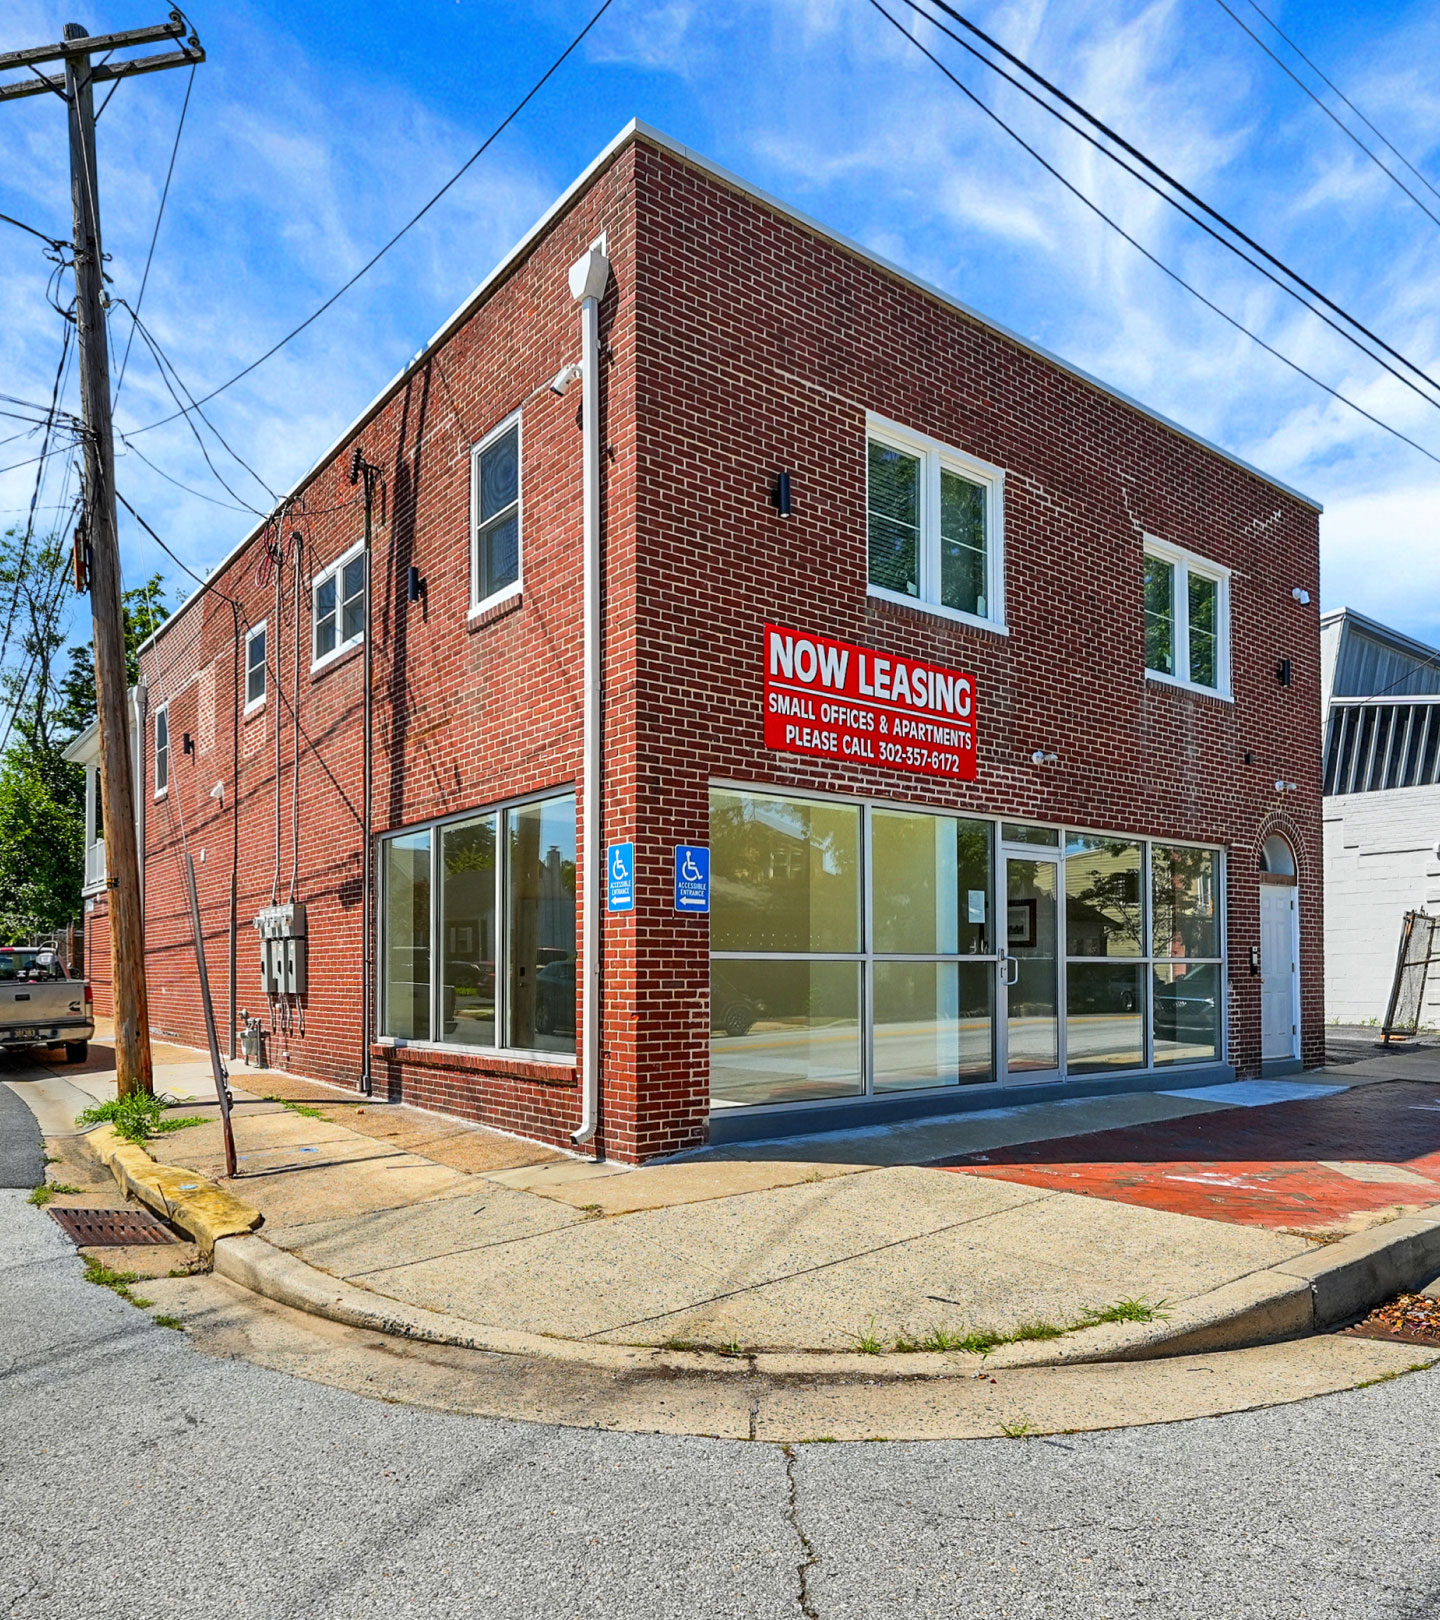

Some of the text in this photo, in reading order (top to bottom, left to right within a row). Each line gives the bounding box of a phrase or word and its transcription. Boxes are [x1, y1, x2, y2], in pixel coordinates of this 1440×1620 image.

[770, 632, 971, 716] NOW LEASING
[768, 692, 972, 750] SMALL OFFICES & APARTMENTS
[786, 724, 960, 773] PLEASE CALL 302-357-6172
[678, 882, 706, 890] ACCESSIBLE
[680, 889, 705, 897] ENTRANCE
